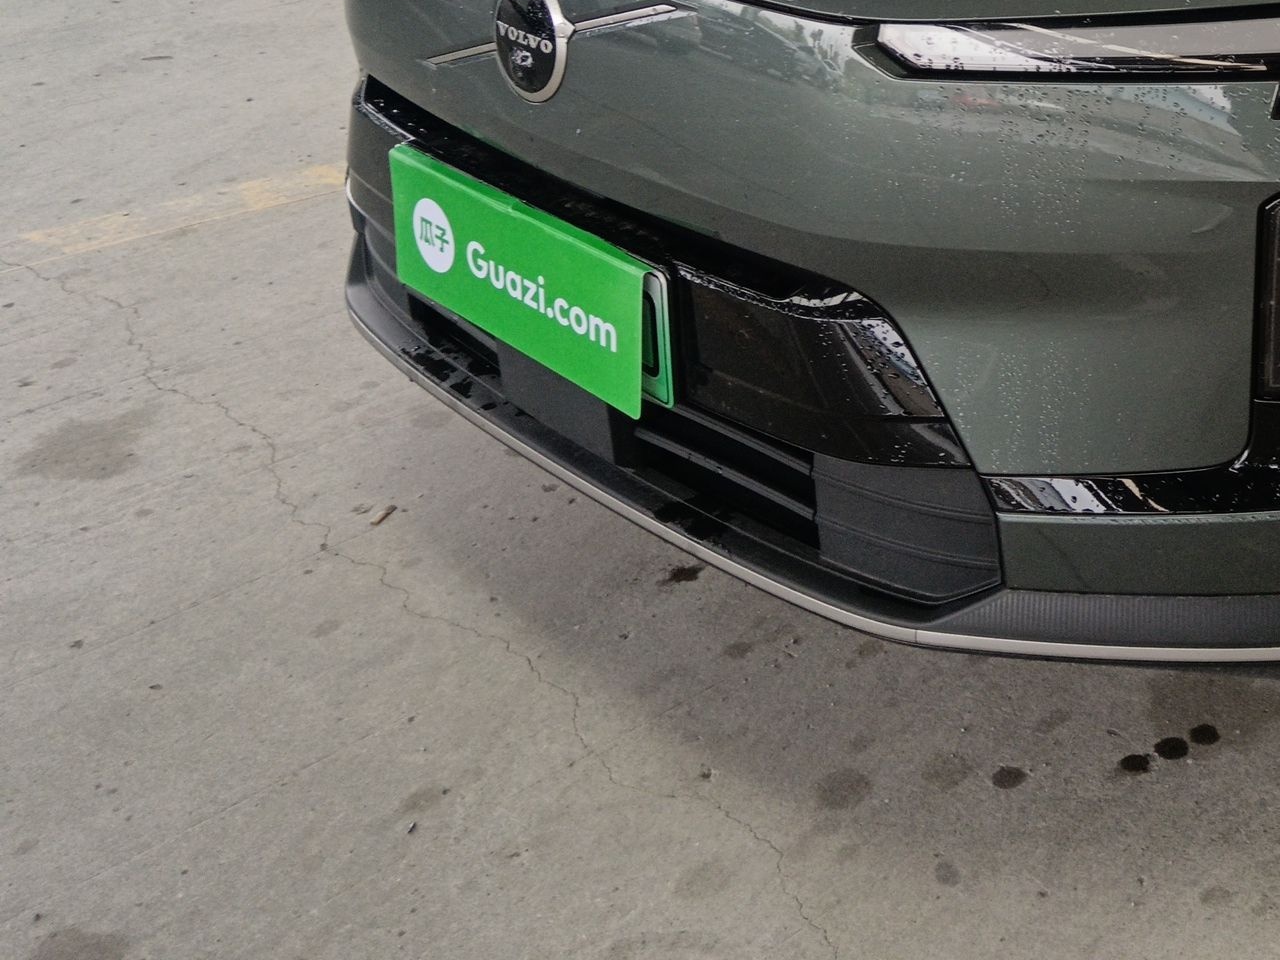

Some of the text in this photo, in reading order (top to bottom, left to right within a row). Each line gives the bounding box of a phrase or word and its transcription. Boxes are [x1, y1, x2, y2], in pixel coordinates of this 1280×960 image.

[496, 20, 554, 54] VOLVO
[419, 216, 450, 253] 瓜子
[466, 240, 618, 353] Guazi.com
